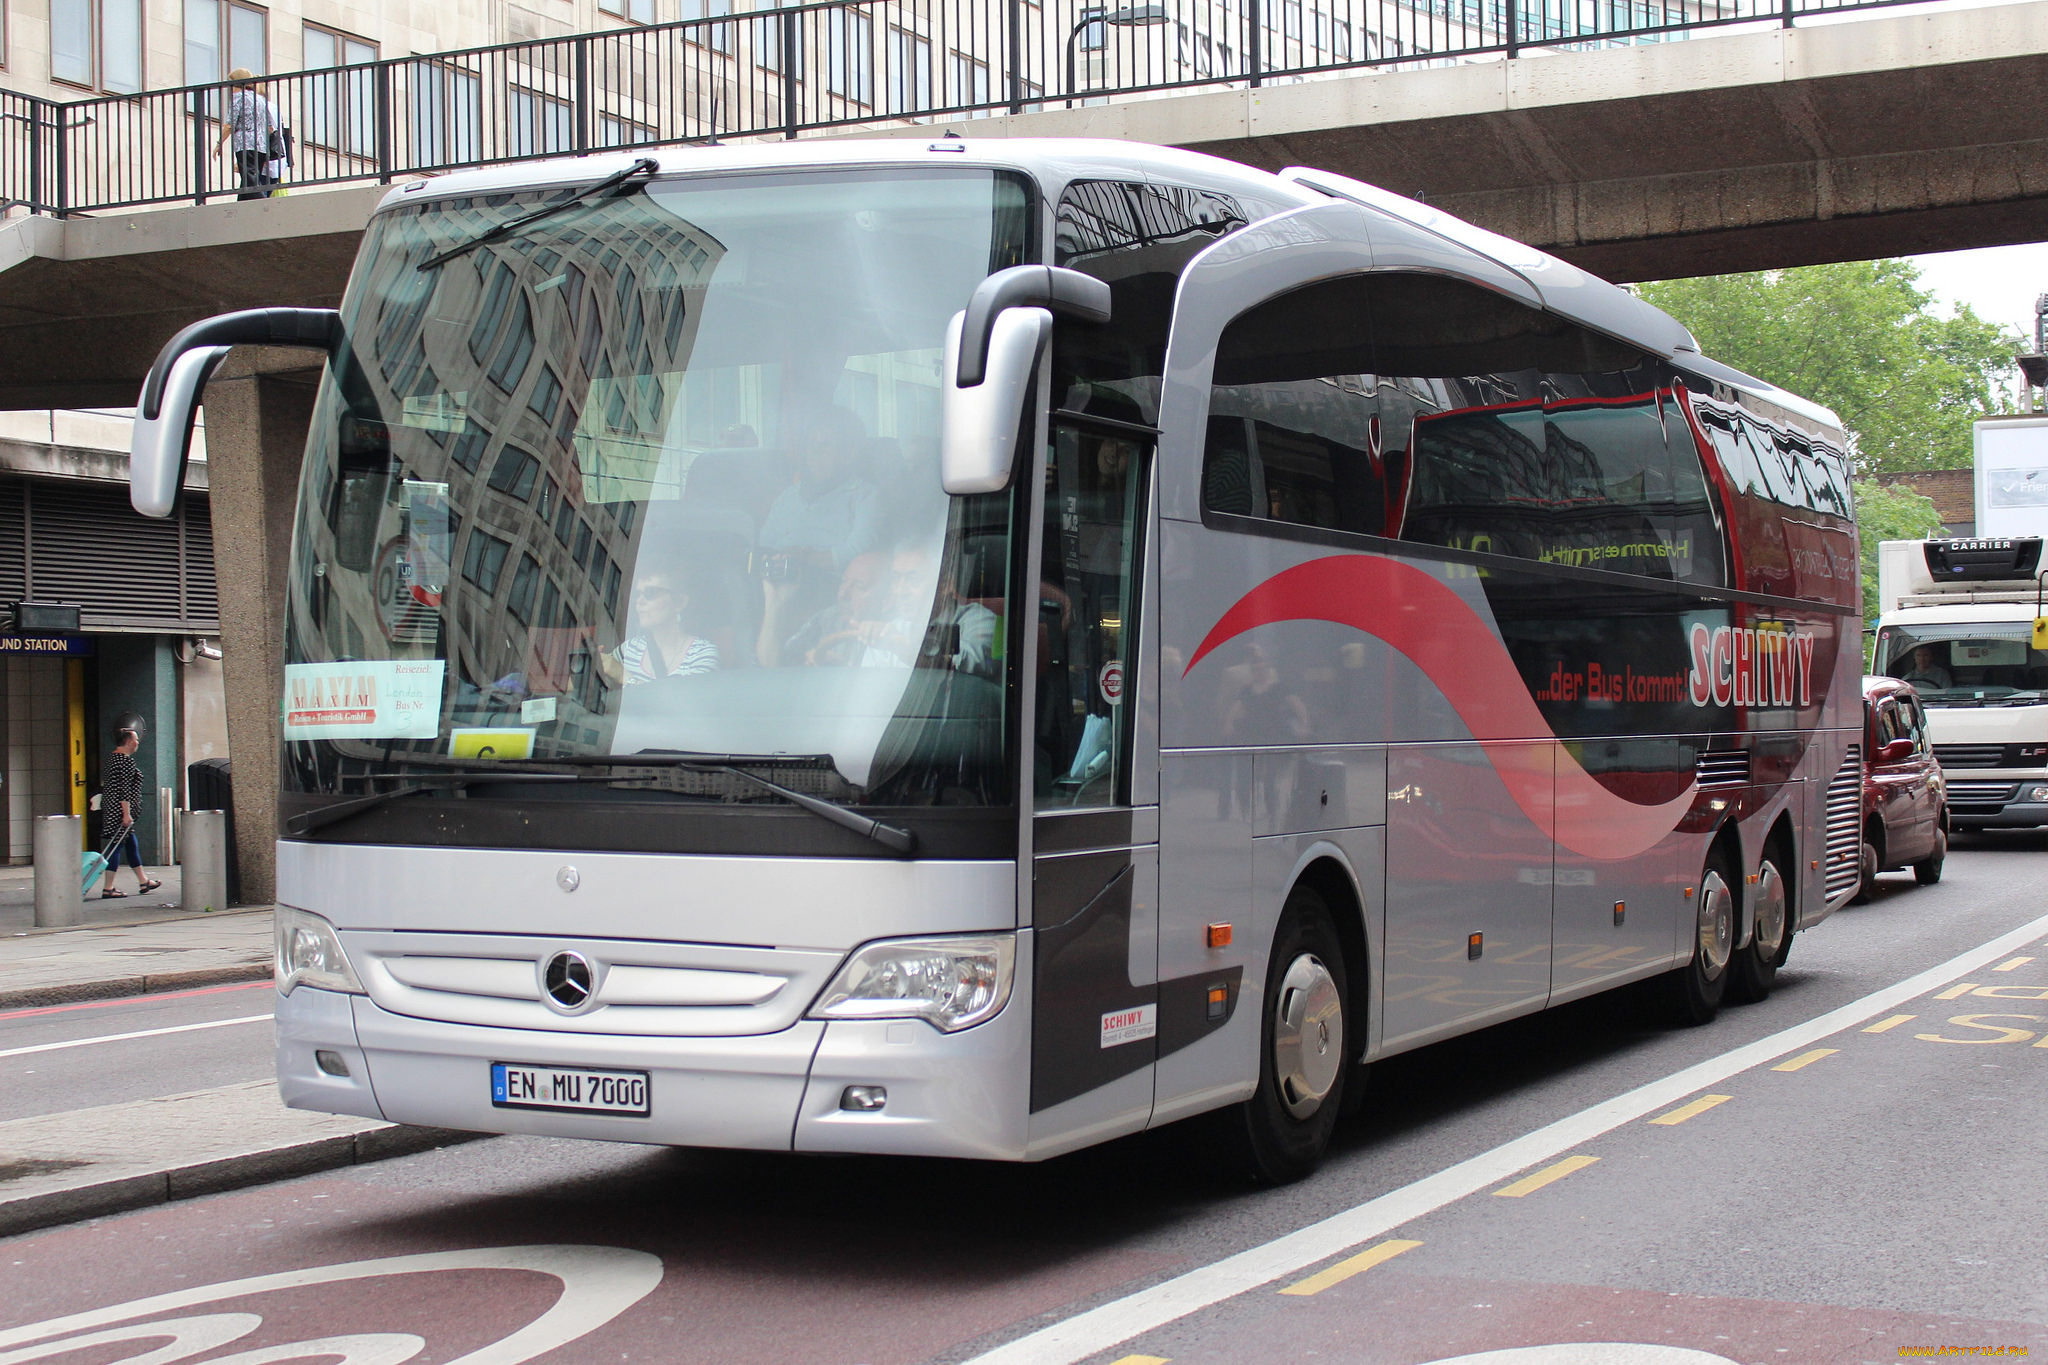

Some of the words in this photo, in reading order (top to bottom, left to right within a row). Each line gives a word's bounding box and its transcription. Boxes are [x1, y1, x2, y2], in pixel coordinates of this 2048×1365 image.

[1951, 541, 2011, 550] CARRIER
[24, 638, 68, 651] STATION
[1689, 623, 1814, 707] SCHIWY
[1587, 662, 1623, 702] Bus
[1626, 664, 1689, 703] kommt!
[396, 700, 409, 710] Bus
[1104, 1010, 1143, 1031] SCHIWY
[508, 1071, 535, 1099] EN
[553, 1074, 581, 1102] MU
[588, 1076, 645, 1106] 7000
